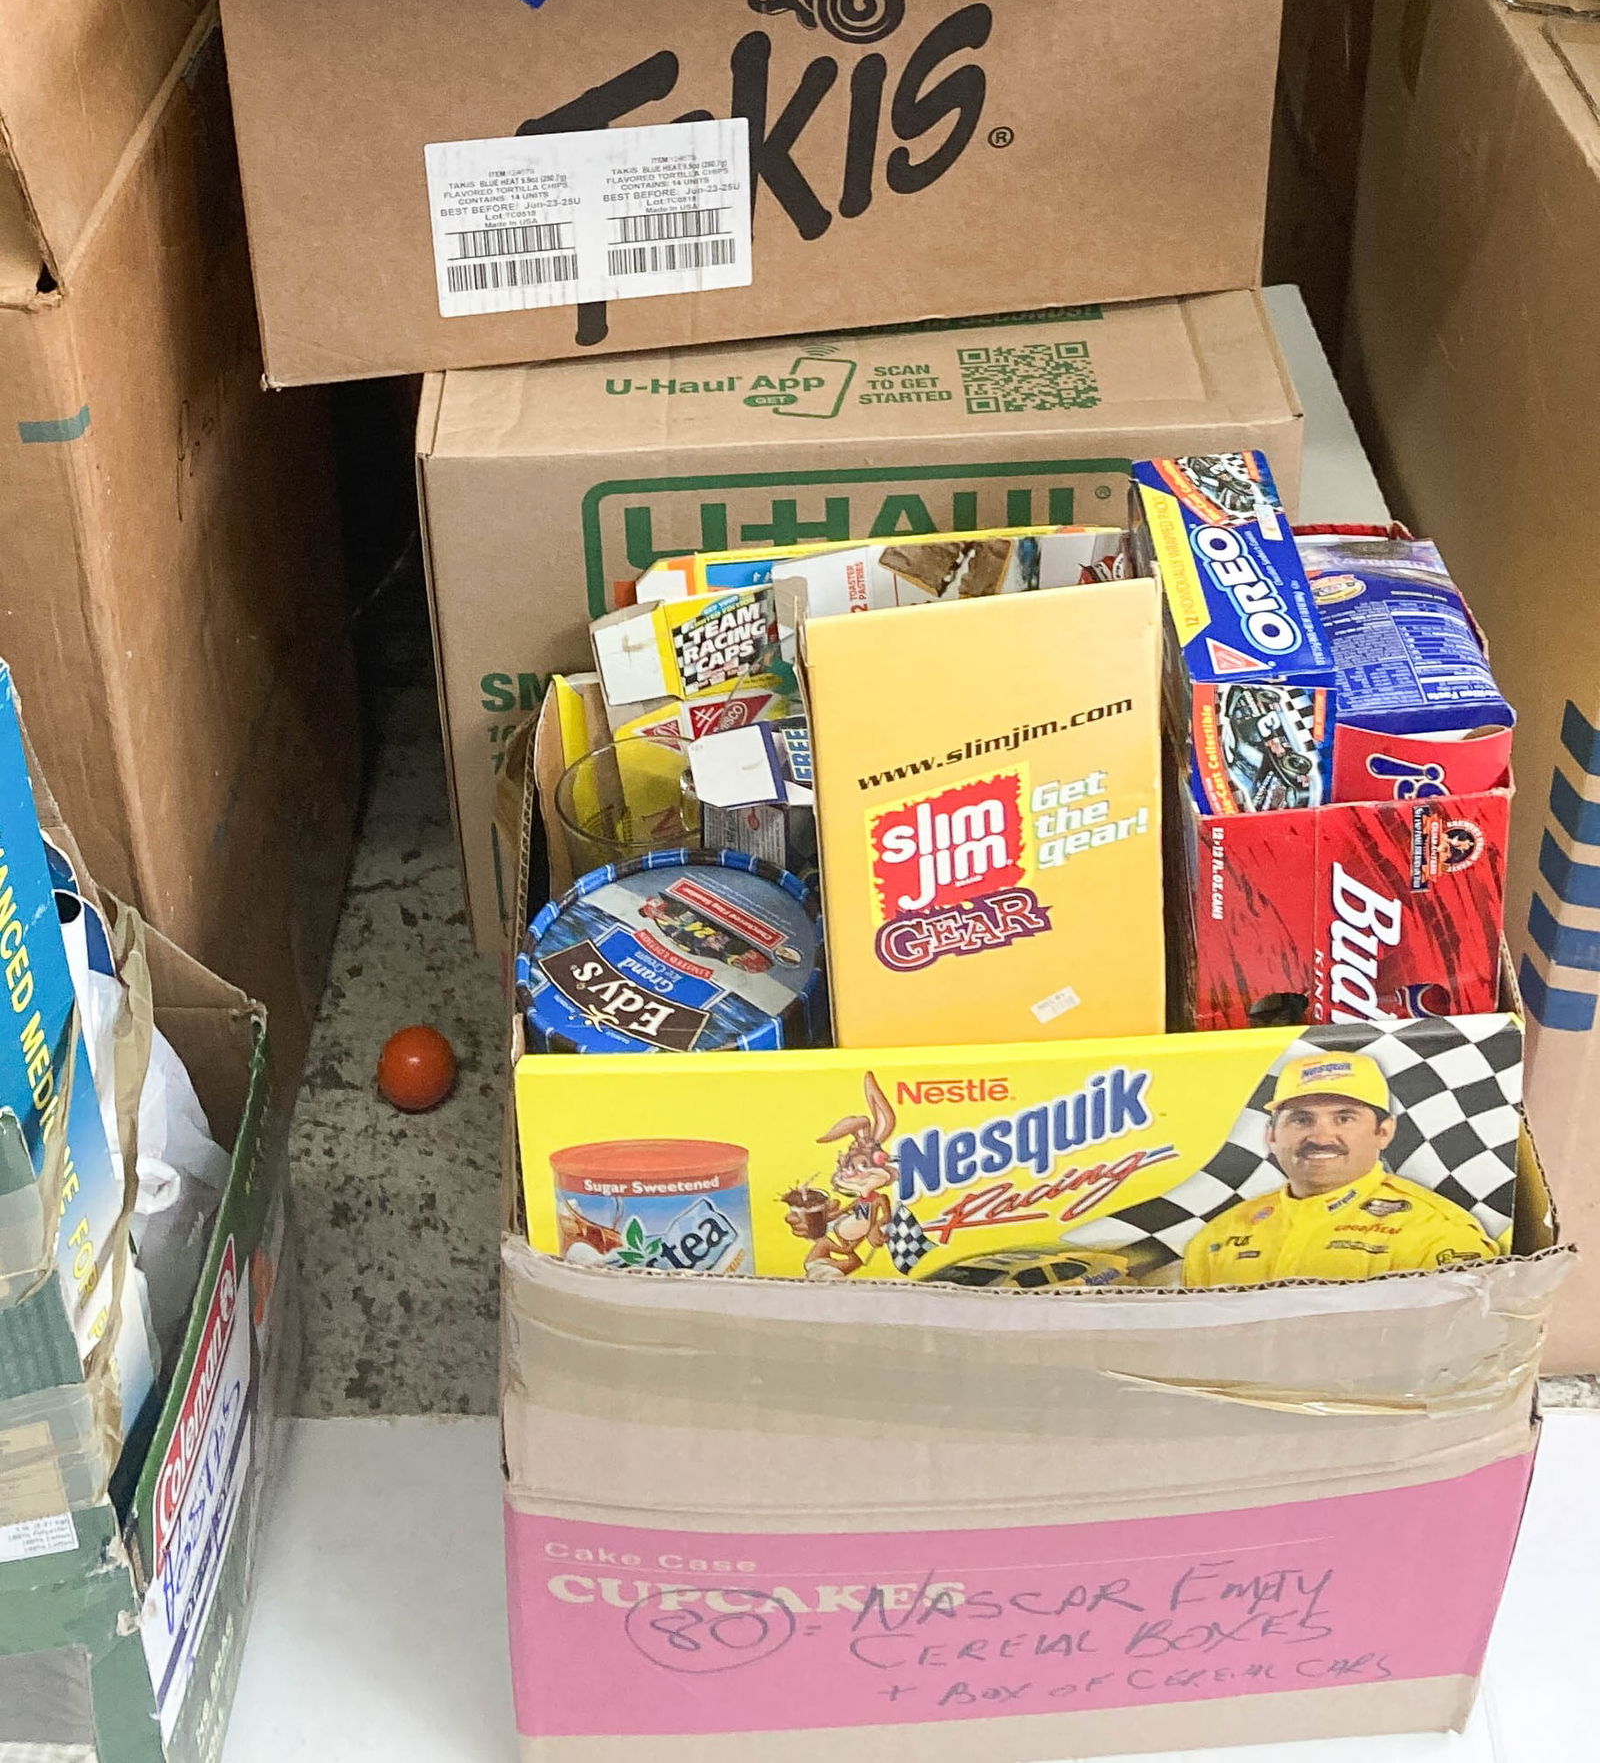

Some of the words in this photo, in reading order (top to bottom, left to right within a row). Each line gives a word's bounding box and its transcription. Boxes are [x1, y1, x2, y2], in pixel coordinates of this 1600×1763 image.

[480, 178, 499, 188] BLUE
[501, 177, 519, 187] HEAT
[606, 175, 655, 185] FLAVORED
[658, 171, 699, 181] TORTILLA
[642, 165, 661, 173] BLUE
[684, 177, 709, 186] UNITS
[443, 189, 493, 199] FLAVORED
[496, 185, 539, 195] TORTILLA
[541, 182, 568, 191] CHIPS
[522, 192, 549, 201] UNITS
[603, 193, 631, 203] BEST
[680, 203, 698, 211] USA
[440, 207, 468, 217] BEST
[484, 220, 508, 229] Made
[519, 219, 538, 227] USA
[750, 375, 825, 392] App
[867, 379, 897, 390] TO
[900, 377, 938, 389] GET
[873, 364, 930, 377] SCAN
[754, 395, 787, 405] GET
[858, 390, 953, 405] STARTED
[846, 565, 857, 600] TOASTER
[1196, 525, 1297, 651] OREO
[689, 602, 761, 644] TEAM
[683, 619, 766, 665] RACING
[695, 639, 754, 674] CAPS
[784, 729, 812, 780] FREE
[857, 697, 1133, 791] www.slimjim.com
[1202, 704, 1220, 770] Collectible
[1031, 769, 1108, 813] Get
[1034, 798, 1110, 839] the
[1038, 806, 1150, 871] gear!
[880, 892, 1046, 968] GEAR
[617, 957, 674, 993] Grand
[572, 962, 675, 1036] Edy's
[899, 1068, 1149, 1203] Nesquik
[584, 1179, 627, 1195] Sugar
[631, 1175, 720, 1194] Sweetened
[922, 1148, 1178, 1245] Racing
[159, 1315, 227, 1531] Coleman
[544, 1540, 643, 1568] Cake
[658, 1552, 758, 1573] Case
[546, 1573, 968, 1616] CUPCAKES
[651, 1609, 769, 1652] 80
[851, 1567, 1145, 1633] NASCAR
[1124, 1608, 1335, 1658] BOXES
[1048, 1672, 1116, 1699] OF
